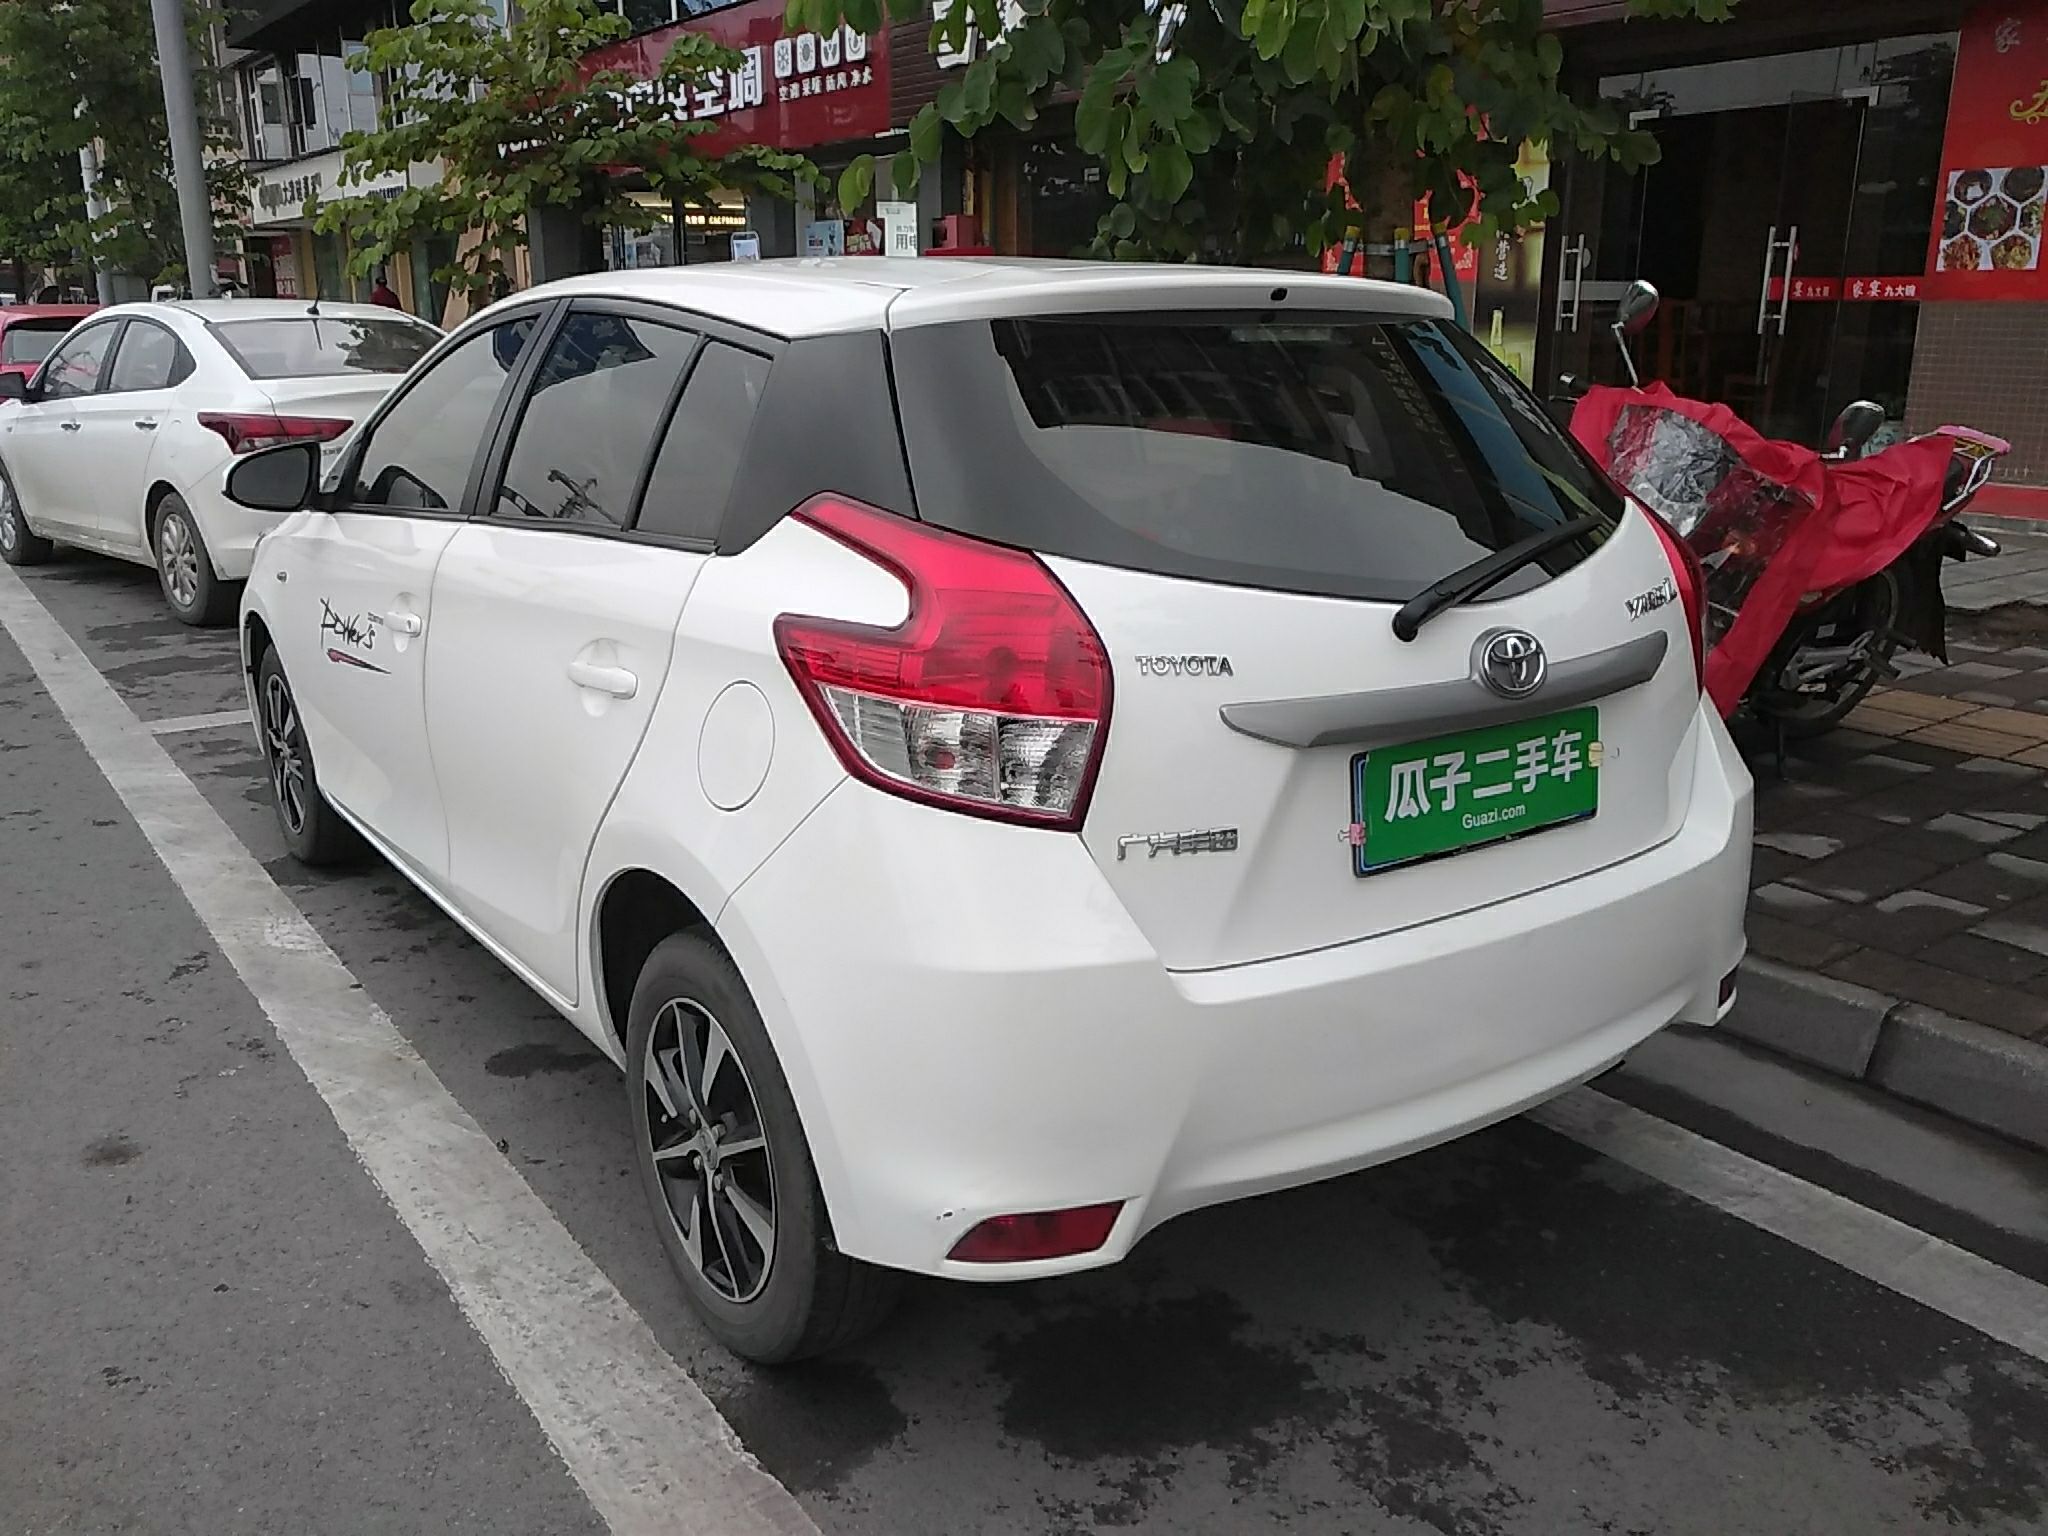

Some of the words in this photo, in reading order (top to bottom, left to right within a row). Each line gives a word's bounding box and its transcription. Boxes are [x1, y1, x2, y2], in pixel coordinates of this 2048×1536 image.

[1135, 655, 1234, 677] TOYOTA
[1384, 729, 1583, 823] 瓜子二手车
[1462, 803, 1526, 829] Guazi.com
